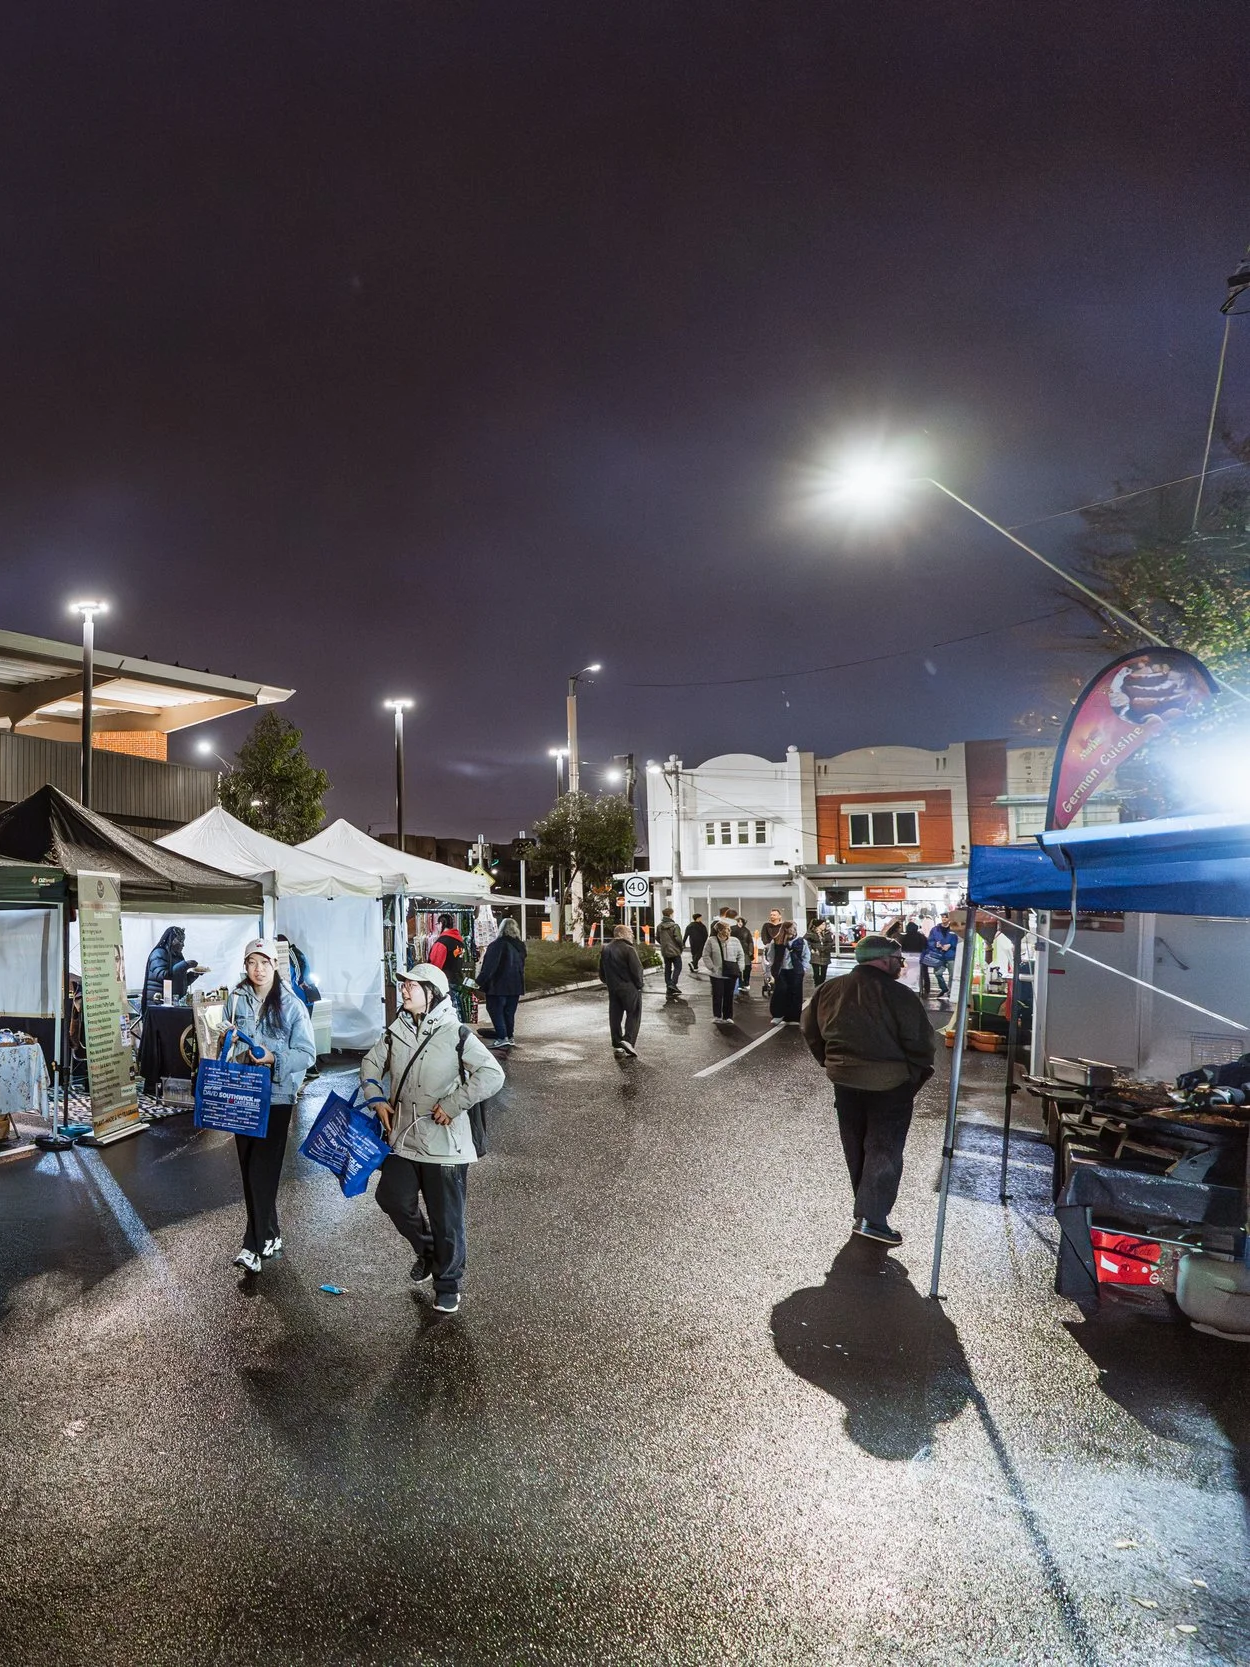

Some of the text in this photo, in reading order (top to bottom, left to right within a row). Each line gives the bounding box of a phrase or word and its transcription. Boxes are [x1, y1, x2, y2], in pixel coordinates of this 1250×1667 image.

[1062, 768, 1100, 813] German
[1100, 727, 1143, 765] Cuisine
[629, 882, 644, 891] 40
[219, 1092, 254, 1102] SOUTHWICK
